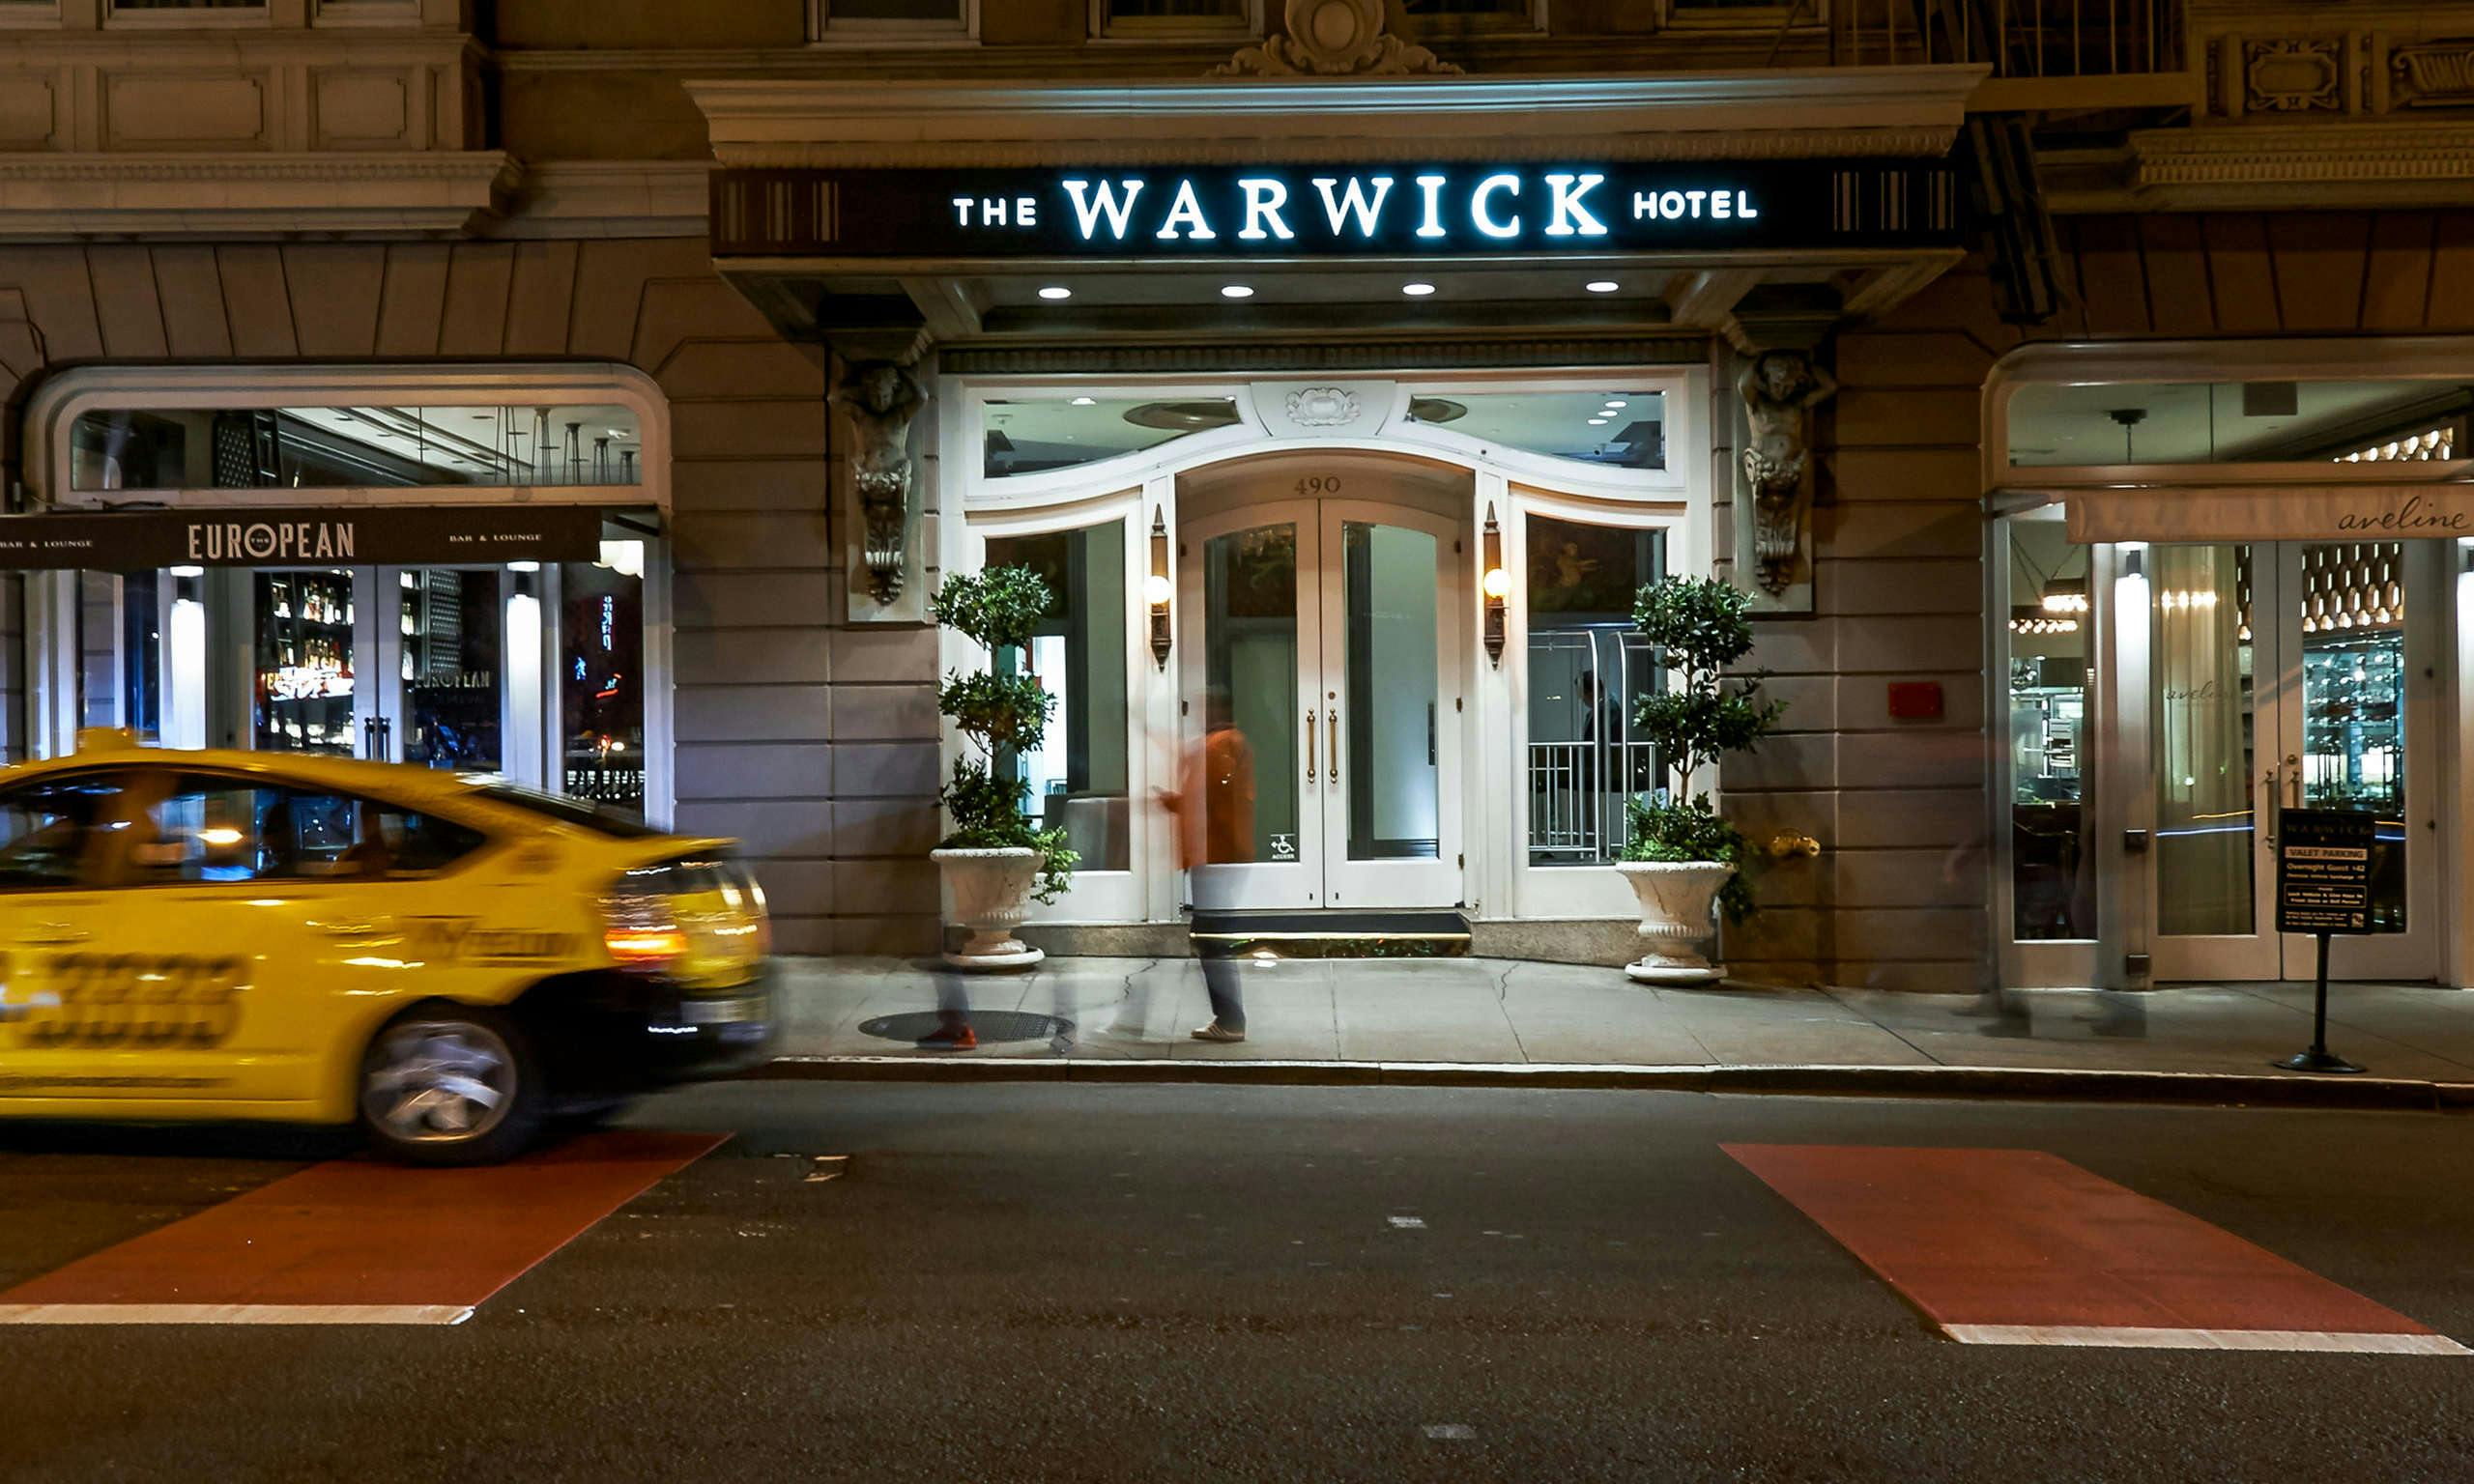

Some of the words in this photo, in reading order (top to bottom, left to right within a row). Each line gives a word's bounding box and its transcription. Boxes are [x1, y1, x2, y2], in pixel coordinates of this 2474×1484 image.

[953, 197, 1037, 226] THE
[1061, 174, 1609, 241] WARWICK
[1633, 190, 1757, 219] HOTEL
[1294, 476, 1341, 495] 490
[2338, 496, 2472, 529] aveline
[188, 523, 355, 559] EUROPEAN
[2322, 849, 2364, 858] PARKING
